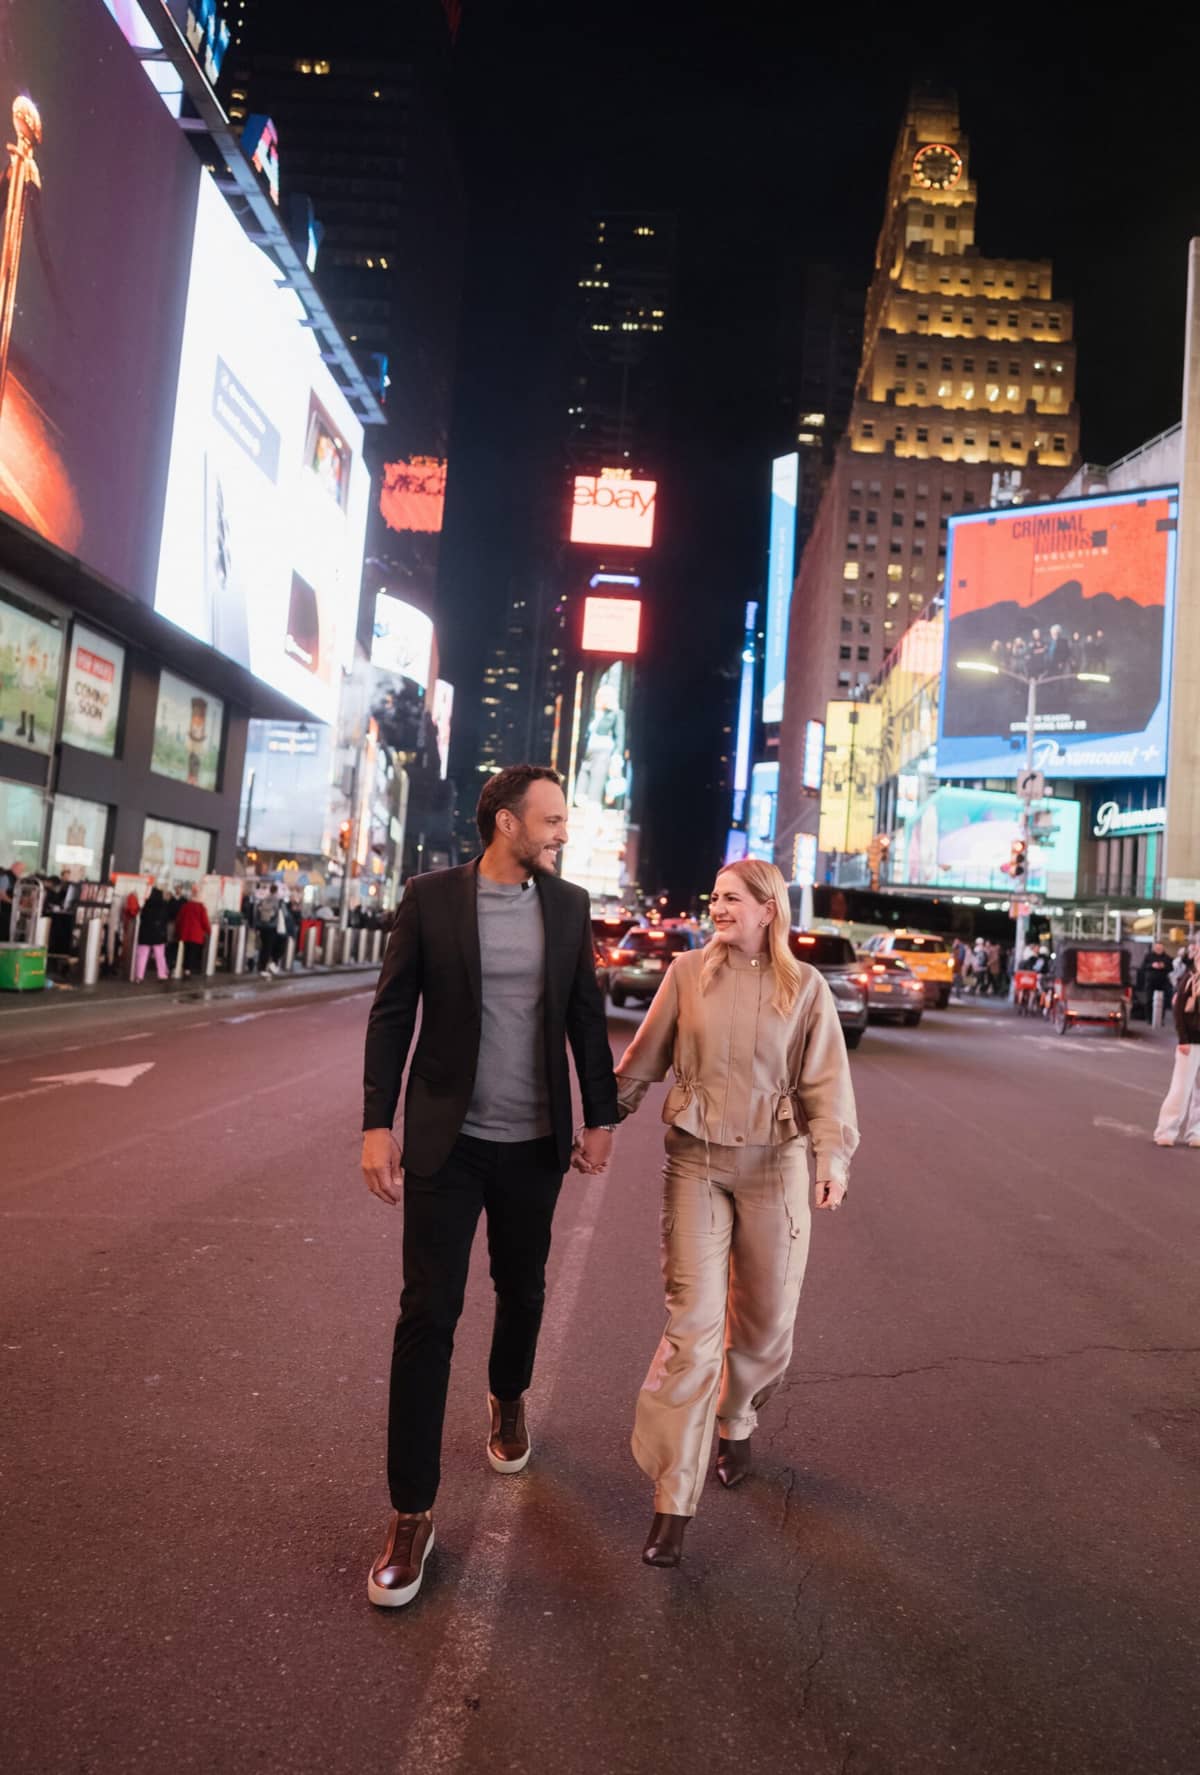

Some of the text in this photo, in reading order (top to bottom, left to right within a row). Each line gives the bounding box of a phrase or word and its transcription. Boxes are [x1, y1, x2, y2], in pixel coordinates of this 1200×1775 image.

[574, 477, 656, 517] ebay
[75, 681, 109, 705] COMING
[79, 699, 103, 720] SOON
